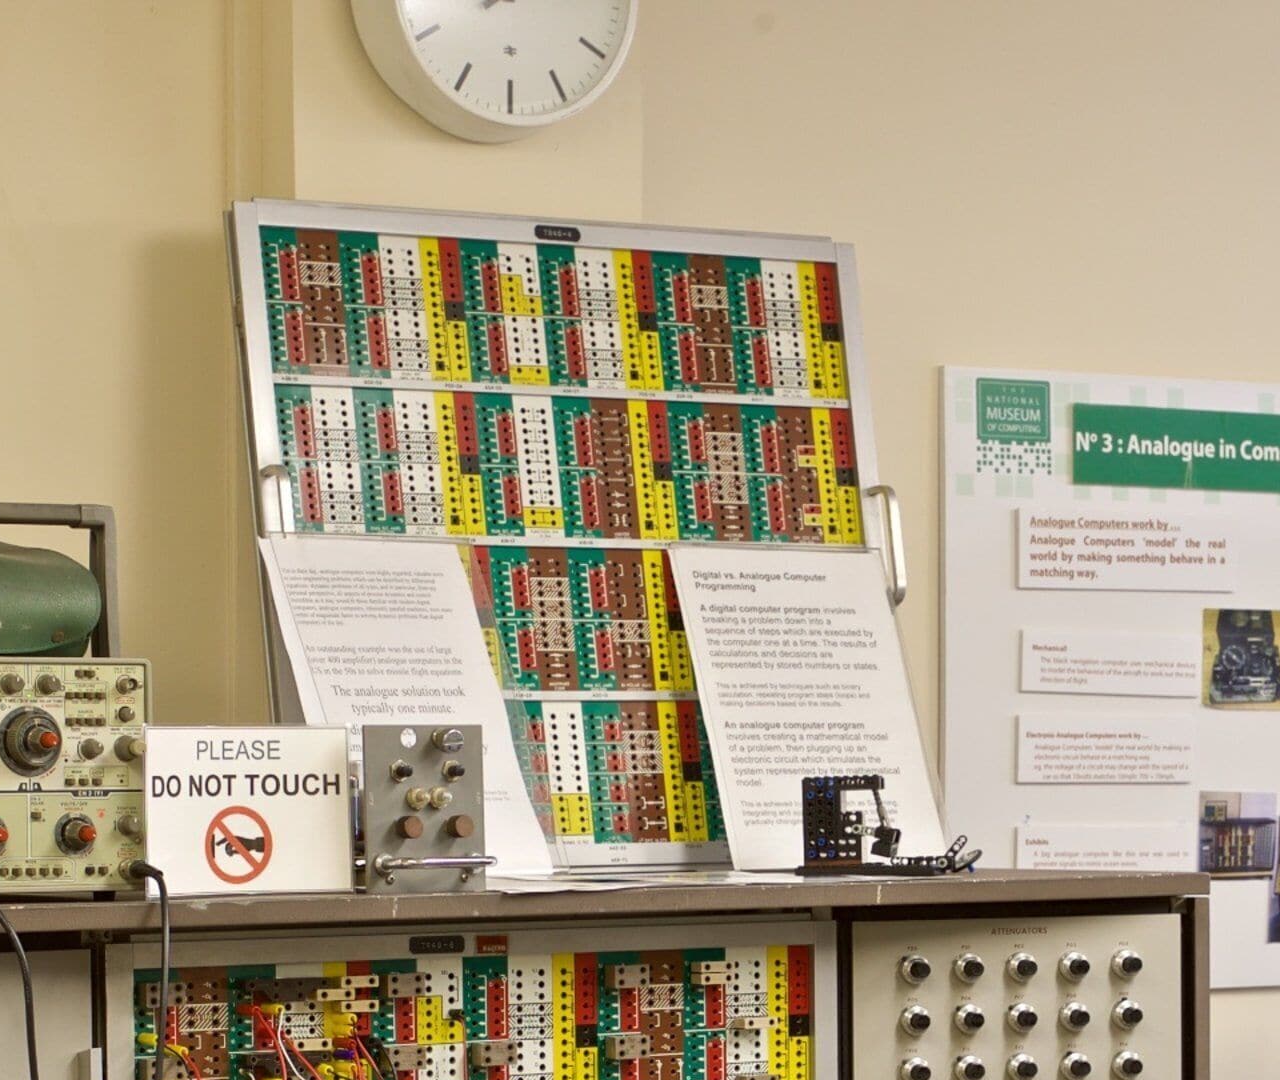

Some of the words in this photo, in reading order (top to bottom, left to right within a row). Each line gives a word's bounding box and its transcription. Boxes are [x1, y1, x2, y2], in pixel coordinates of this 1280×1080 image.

[986, 395, 1040, 405] NATIONAL
[986, 408, 1040, 422] MUSEUM
[987, 423, 996, 431] OF
[998, 423, 1040, 433] COMPUTING
[1102, 435, 1113, 452] 3
[1127, 435, 1215, 462] Analogue
[1220, 440, 1236, 458] in
[1030, 516, 1075, 529] Analogue
[1078, 517, 1129, 529] Computers
[1132, 519, 1153, 529] work
[1030, 535, 1075, 546] Analogue
[1084, 536, 1134, 547] Computers
[1186, 539, 1200, 548] the
[1209, 539, 1225, 549] real
[1030, 552, 1057, 561] world
[1062, 552, 1073, 563] by
[1078, 553, 1112, 564] making
[1117, 553, 1166, 565] something
[1170, 554, 1203, 564] behave
[1208, 555, 1216, 564] in
[692, 571, 720, 580] Digital
[739, 571, 781, 582] Analogue
[784, 572, 826, 583] Computer
[1030, 568, 1074, 579] matching
[695, 582, 756, 592] Programming
[709, 605, 736, 614] digital
[739, 606, 781, 615] computer
[784, 607, 820, 616] program
[702, 616, 738, 625] breaking
[749, 617, 781, 627] problem
[705, 628, 745, 637] sequence
[758, 628, 780, 637] steps
[783, 628, 806, 636] which
[825, 629, 861, 637] executed
[864, 629, 873, 638] by
[707, 638, 720, 646] the
[723, 639, 762, 648] computer
[840, 640, 867, 648] results
[869, 640, 877, 648] of
[781, 650, 818, 658] decisions
[712, 661, 762, 670] represented
[765, 662, 774, 670] by
[331, 685, 351, 696] The
[354, 686, 398, 698] analogue
[402, 686, 440, 697] solution
[443, 686, 465, 697] took
[352, 703, 394, 716] typically
[398, 705, 416, 713] one
[740, 722, 781, 731] analogue
[783, 722, 824, 731] computer
[828, 723, 864, 731] program
[197, 740, 280, 760] PLEASE
[152, 775, 181, 797] DO
[189, 775, 236, 796] NOT
[245, 774, 340, 796] TOUCH
[991, 927, 1048, 935] ATTENUATORS
